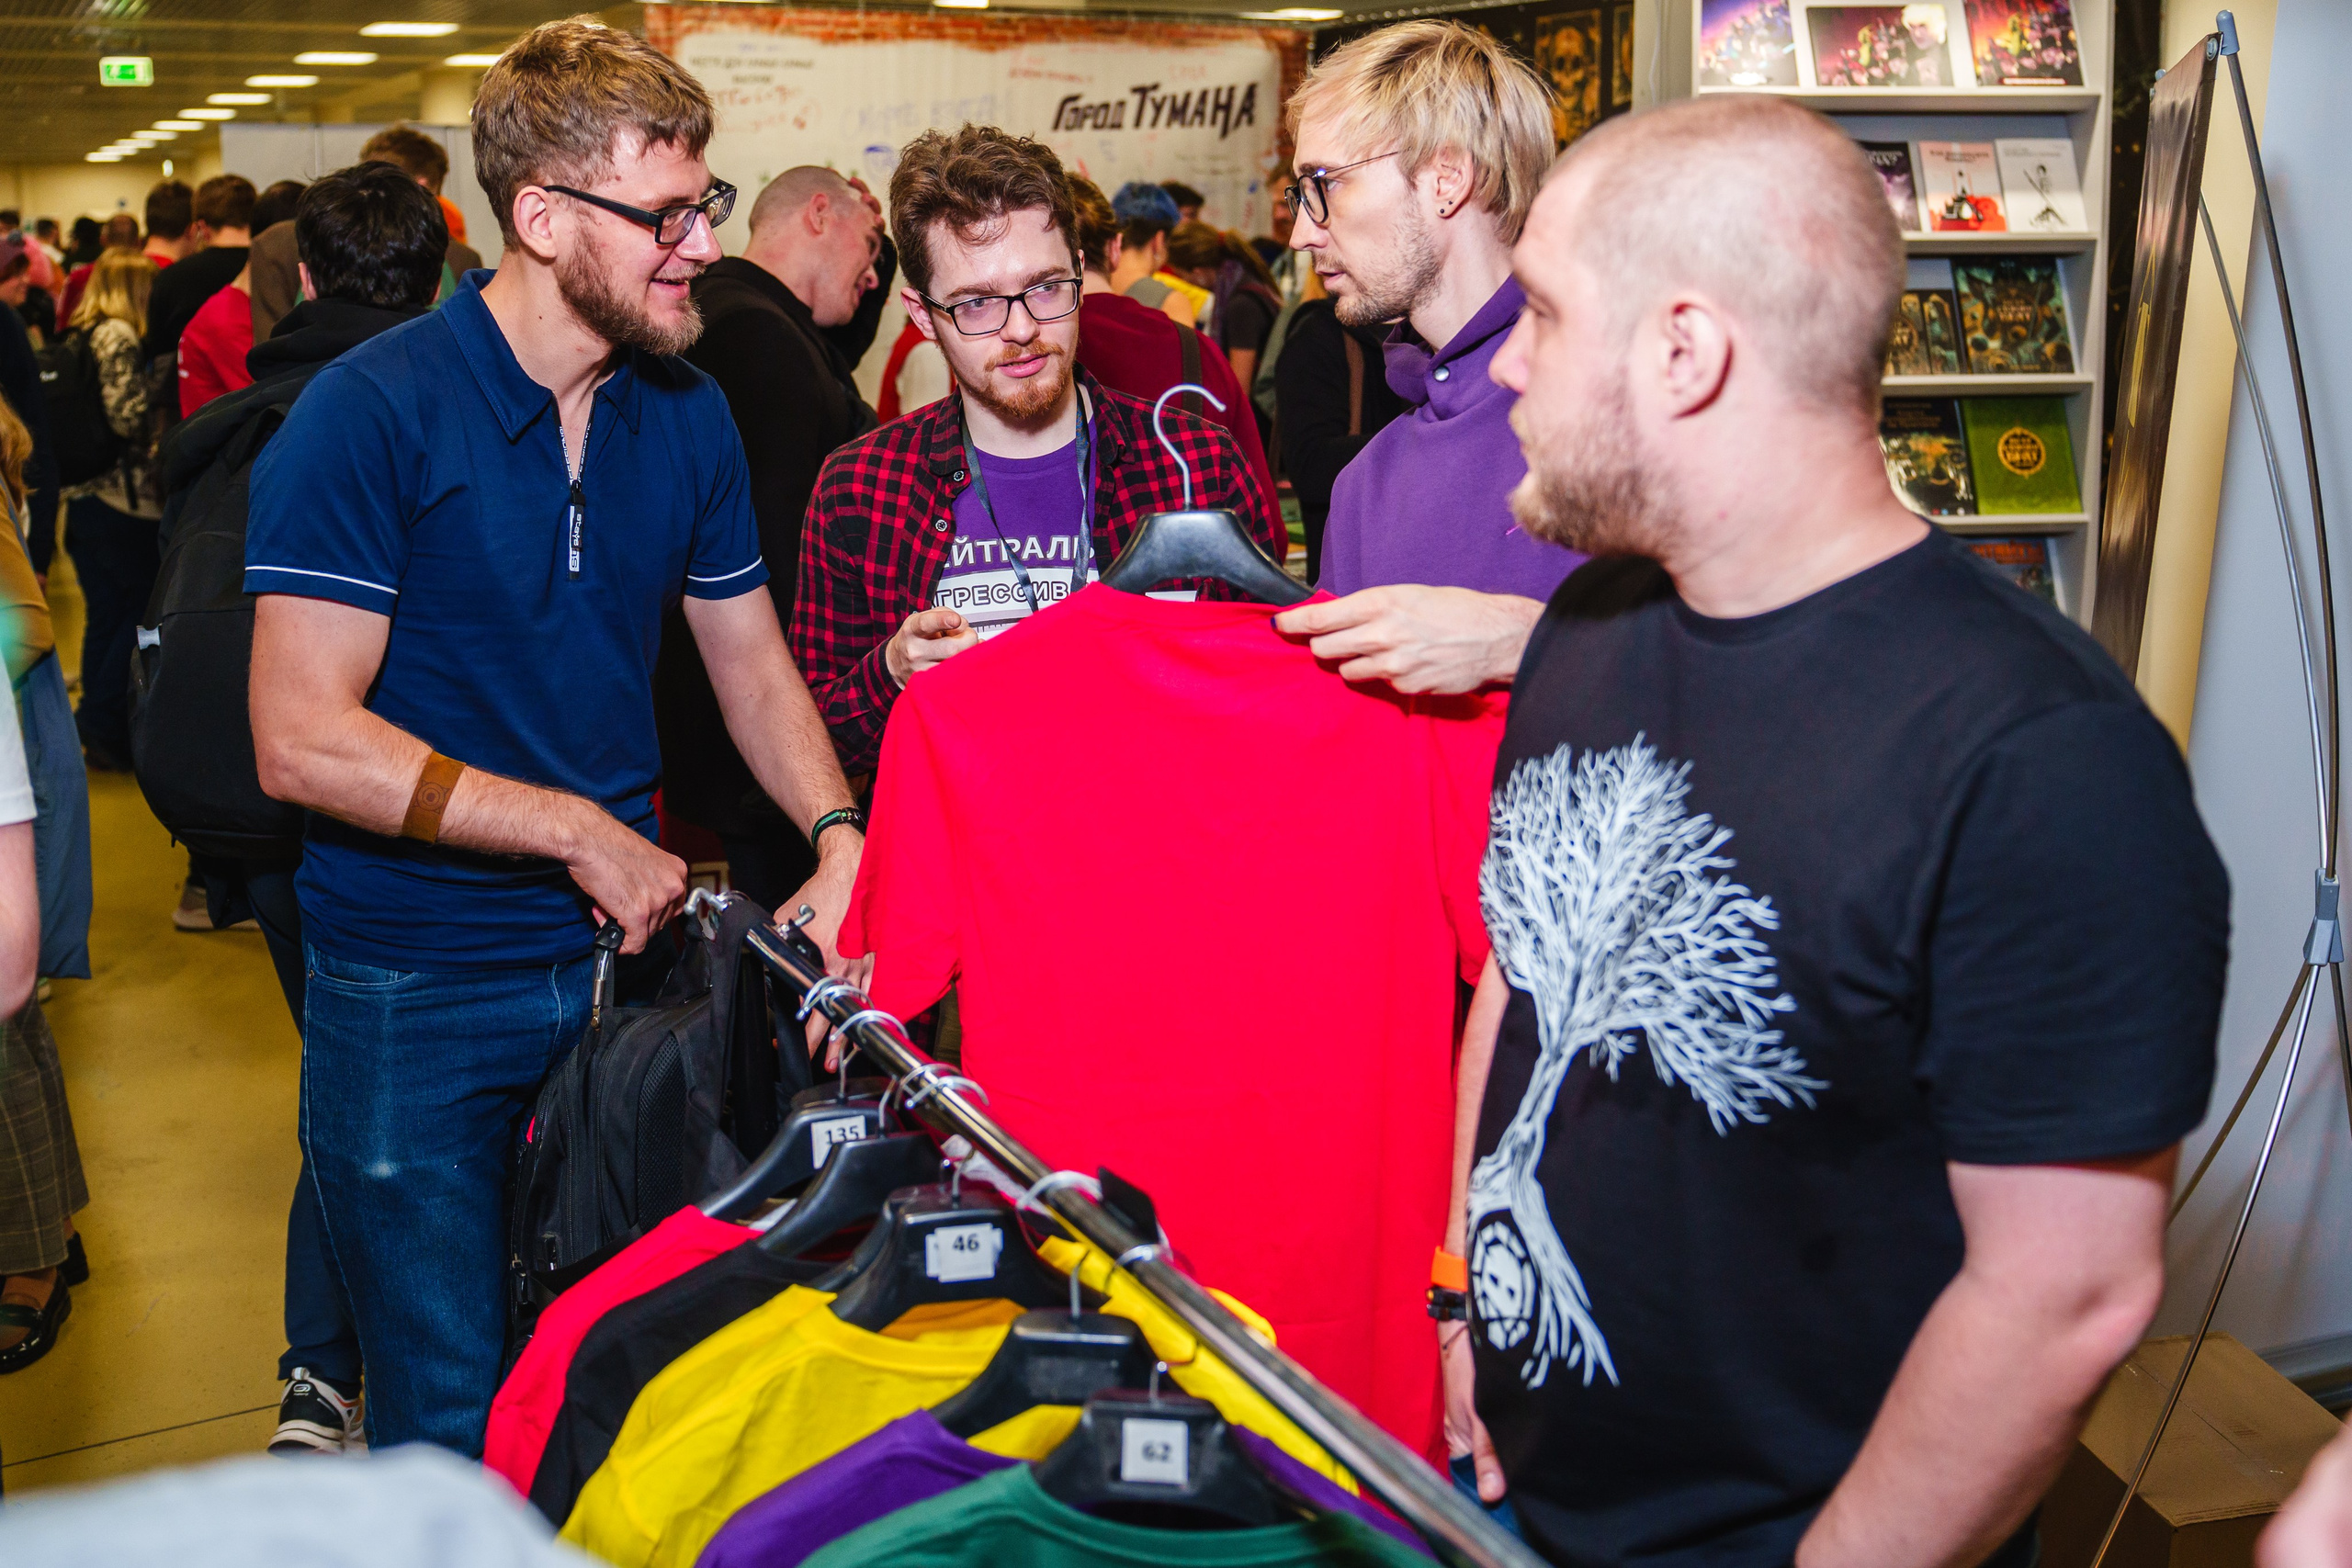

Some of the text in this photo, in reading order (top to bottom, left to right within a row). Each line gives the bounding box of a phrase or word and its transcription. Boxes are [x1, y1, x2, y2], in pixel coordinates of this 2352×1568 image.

[932, 581, 1069, 609] ГРЕССИВ
[825, 1125, 860, 1146] 135
[952, 1233, 980, 1252] 46
[1141, 1440, 1173, 1464] 62
